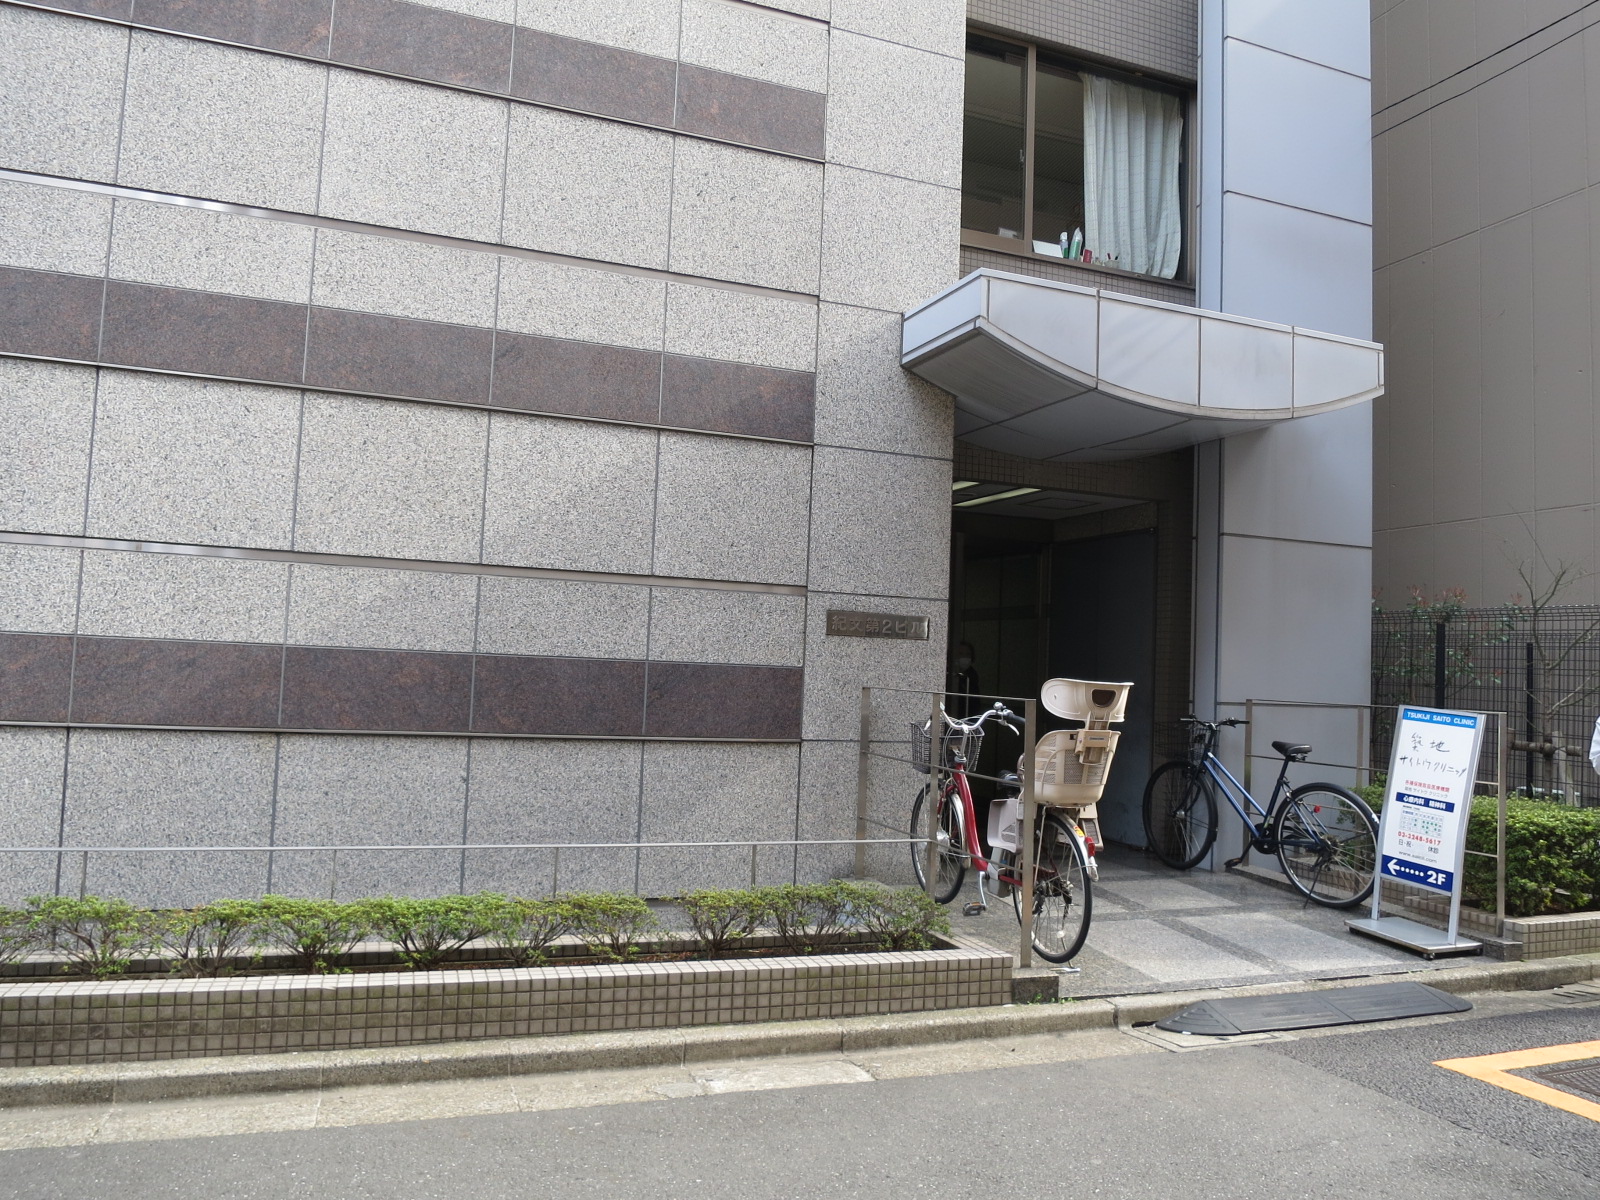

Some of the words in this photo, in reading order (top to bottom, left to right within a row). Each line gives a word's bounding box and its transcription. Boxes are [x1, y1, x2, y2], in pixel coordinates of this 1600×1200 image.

[832, 615, 925, 635] 紀文第2ビル
[1407, 711, 1430, 720] TSUKIJI
[1432, 715, 1451, 723] SAITO
[1453, 717, 1475, 726] CLINIC
[1426, 870, 1447, 885] 2F
